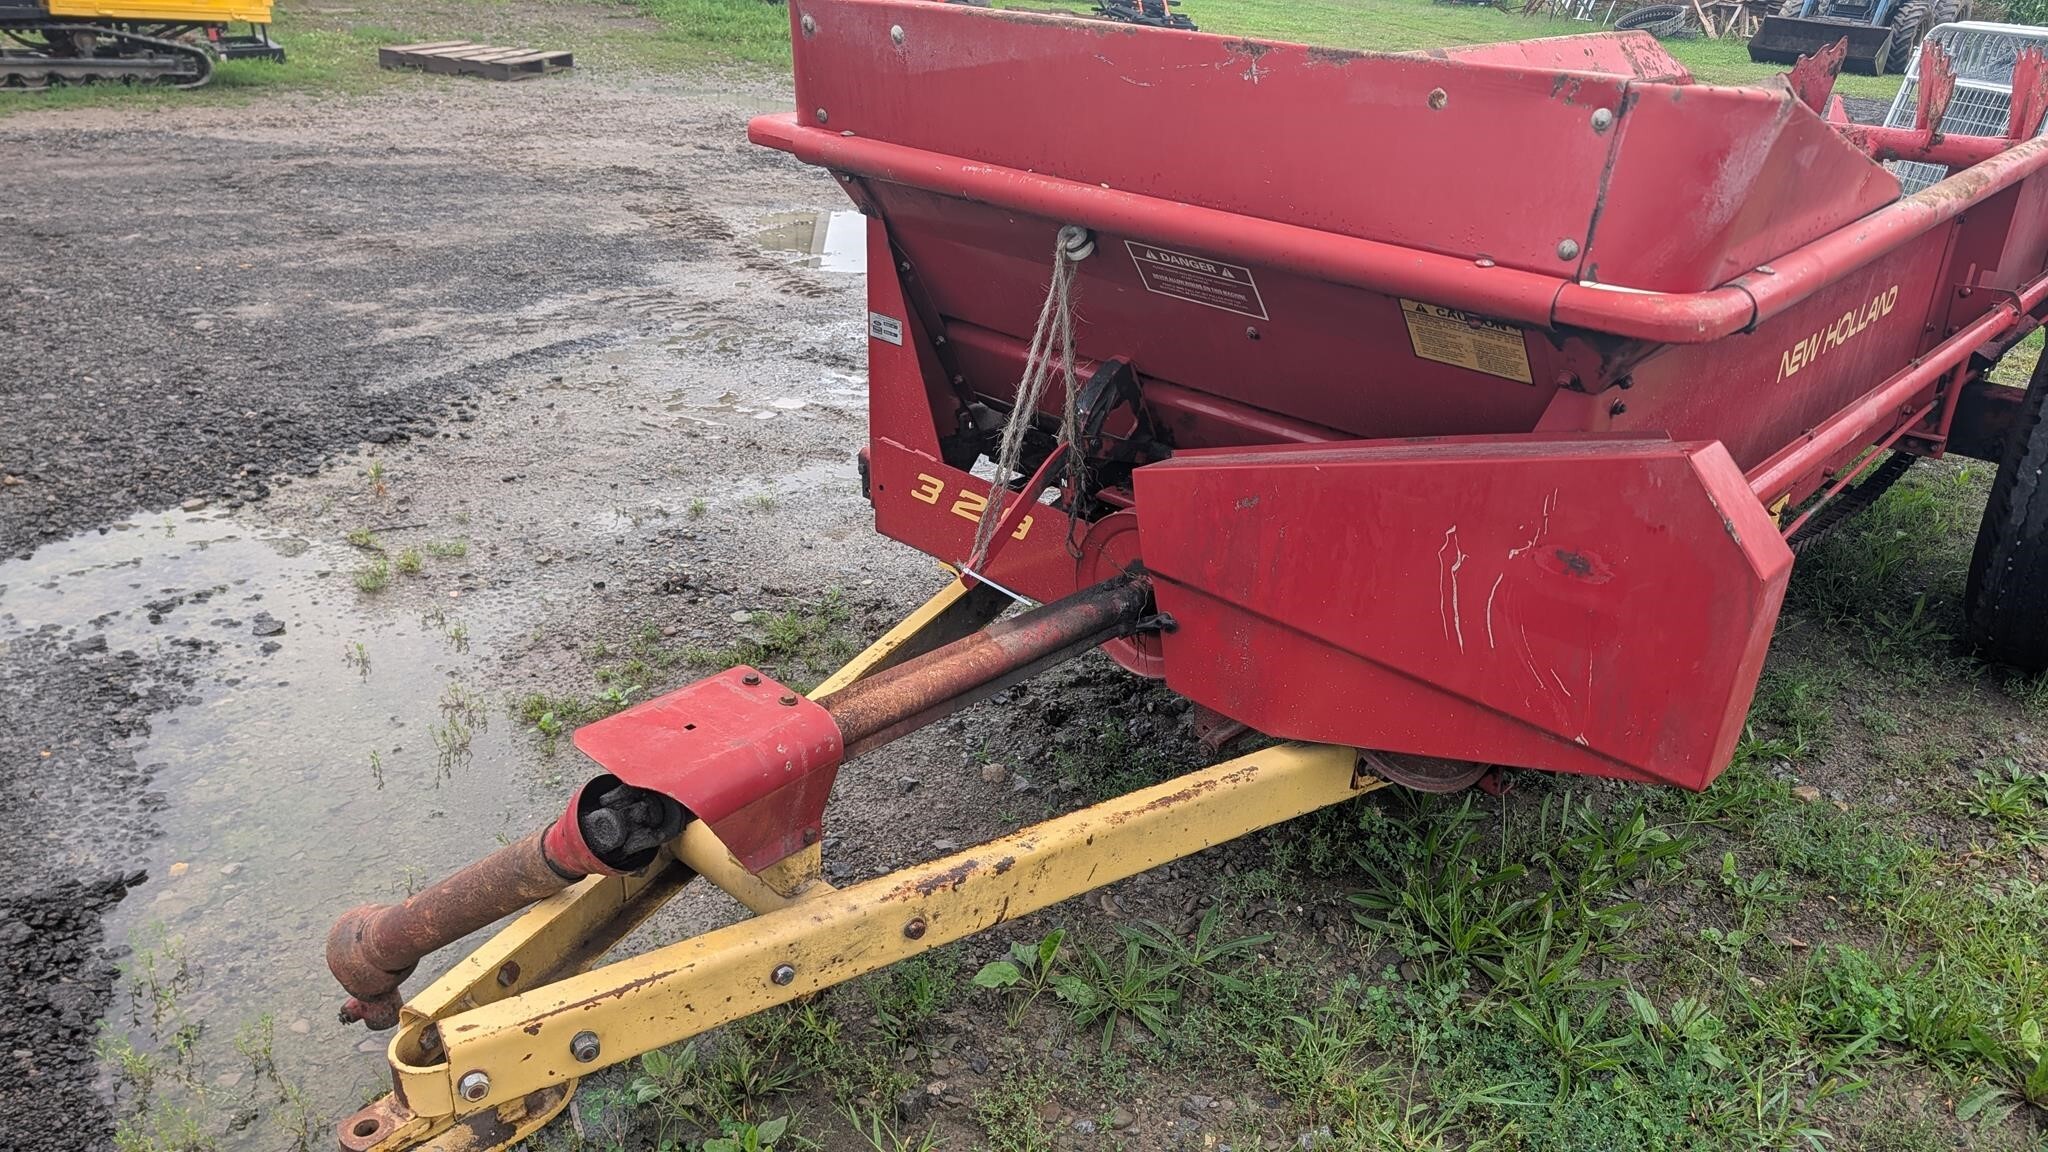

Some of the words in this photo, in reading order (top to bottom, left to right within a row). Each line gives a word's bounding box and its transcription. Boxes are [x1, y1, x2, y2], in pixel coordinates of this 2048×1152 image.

[1160, 252, 1217, 274] DANGER
[1776, 327, 1824, 384] NEW
[1822, 284, 1899, 354] HOLLAND
